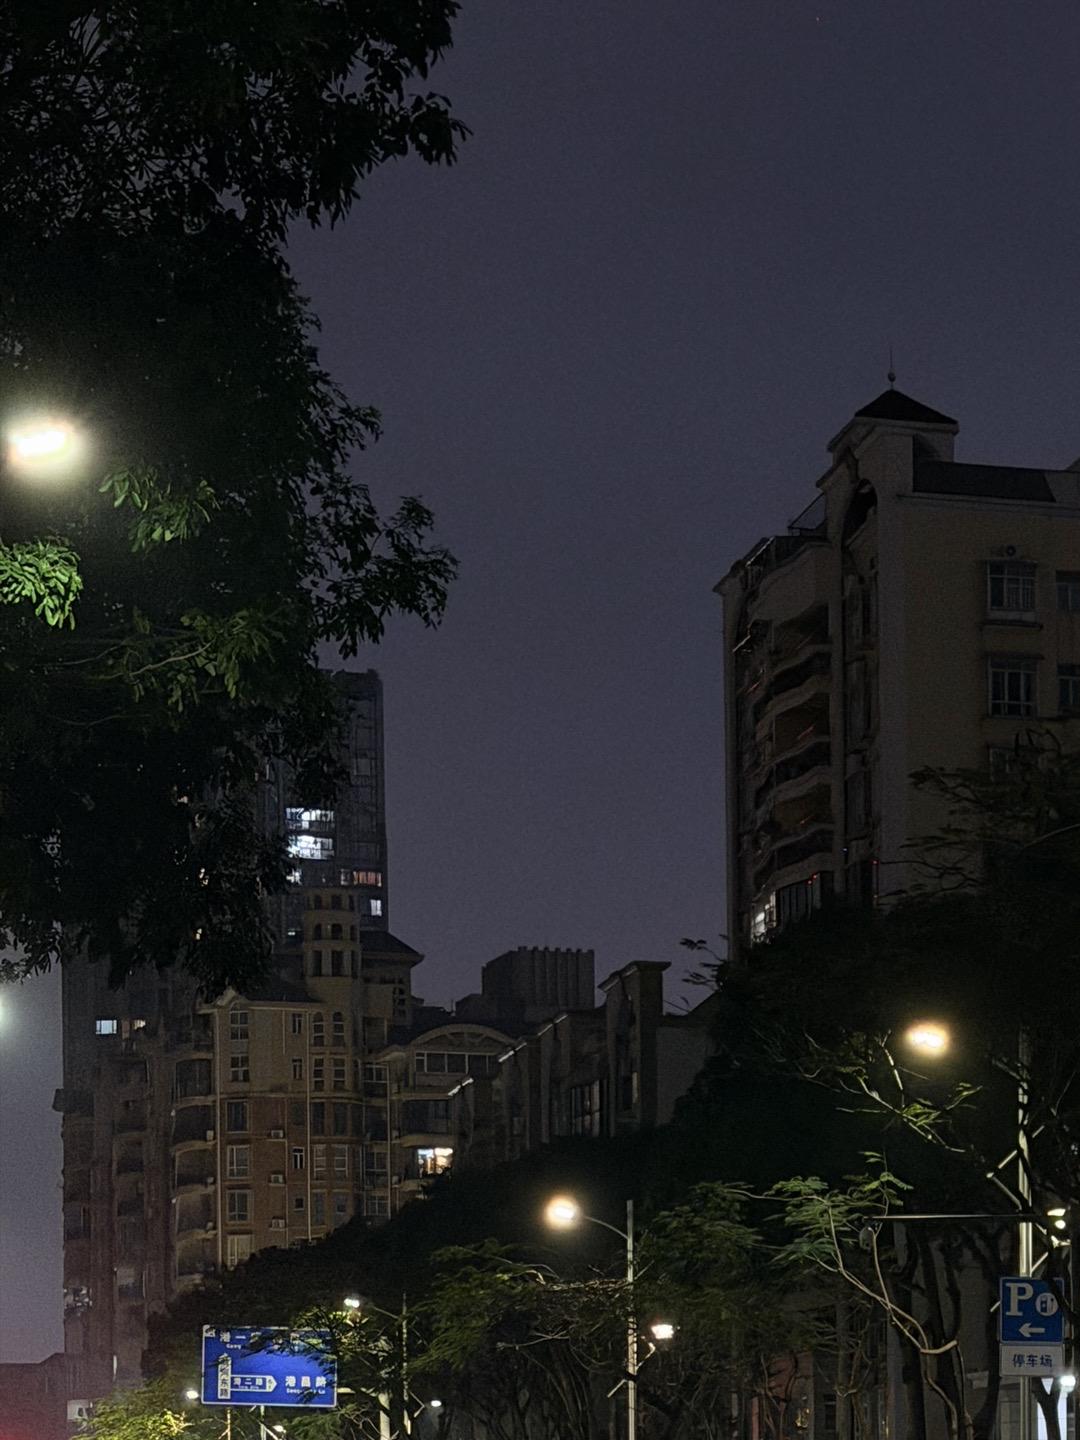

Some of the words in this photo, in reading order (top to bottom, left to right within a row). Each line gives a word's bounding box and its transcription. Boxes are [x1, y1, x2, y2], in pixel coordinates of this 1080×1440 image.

[1005, 1282, 1034, 1317] P
[1011, 1354, 1053, 1368] 停车场
